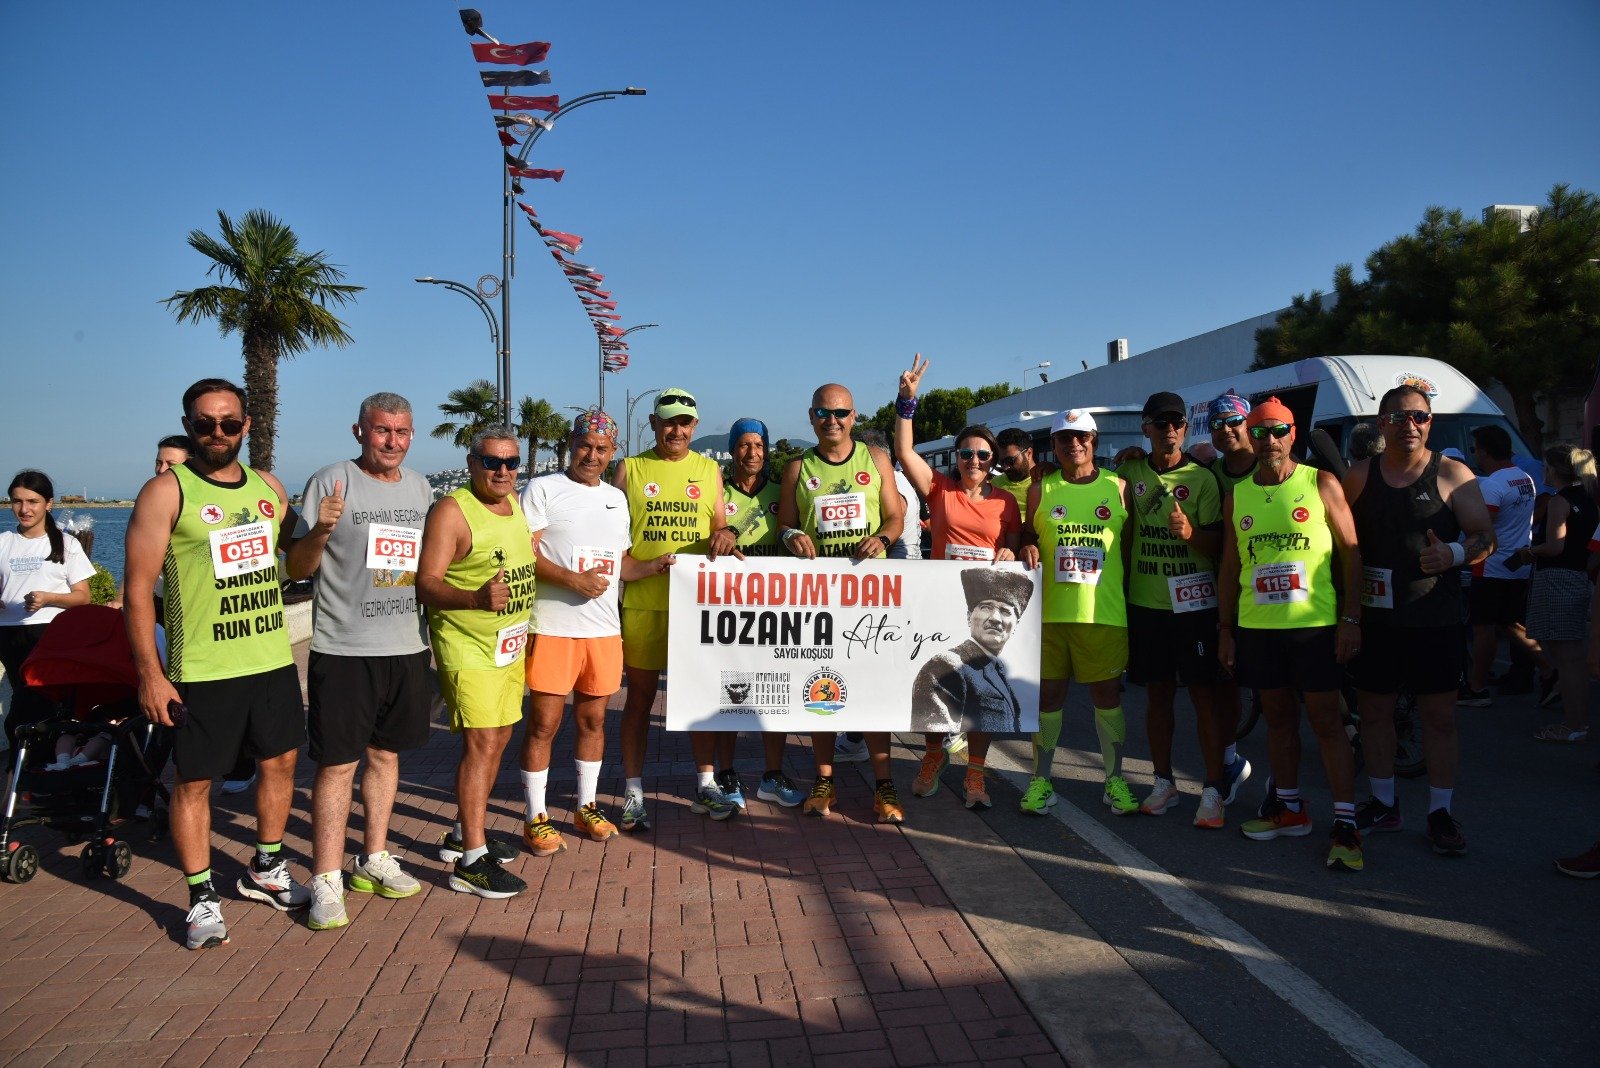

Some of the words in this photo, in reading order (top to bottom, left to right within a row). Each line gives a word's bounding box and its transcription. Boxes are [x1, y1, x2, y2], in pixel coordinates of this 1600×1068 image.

[646, 501, 698, 513] SAMSUN
[826, 506, 857, 520] 005
[352, 508, 392, 525] İBRAHİM
[647, 516, 697, 528] ATAKUM
[643, 530, 666, 541] RUN
[671, 532, 700, 542] CLUB
[1058, 524, 1104, 534] SAMSUN
[227, 540, 264, 560] 055
[380, 540, 413, 557] 098
[1058, 537, 1103, 548] ATAKUM
[1141, 542, 1188, 558] ATAKUM
[1063, 558, 1094, 572] 088
[1138, 560, 1158, 576] RUN
[1162, 562, 1197, 576] CLUB
[697, 563, 902, 607] İLKADIM'DAN
[1180, 584, 1212, 600] 060
[1264, 576, 1290, 592] 115
[220, 588, 279, 616] ATAKUM
[360, 596, 404, 618] VEZİRKÖPRÜ
[212, 619, 251, 641] RUN
[255, 610, 284, 634] CLUB
[700, 610, 834, 646] LOZAN'A
[774, 648, 798, 659] SAYGI
[800, 648, 834, 661] KOŞUSU
[804, 674, 820, 702] ATAKUM
[822, 674, 847, 702] BELEDİYESİ
